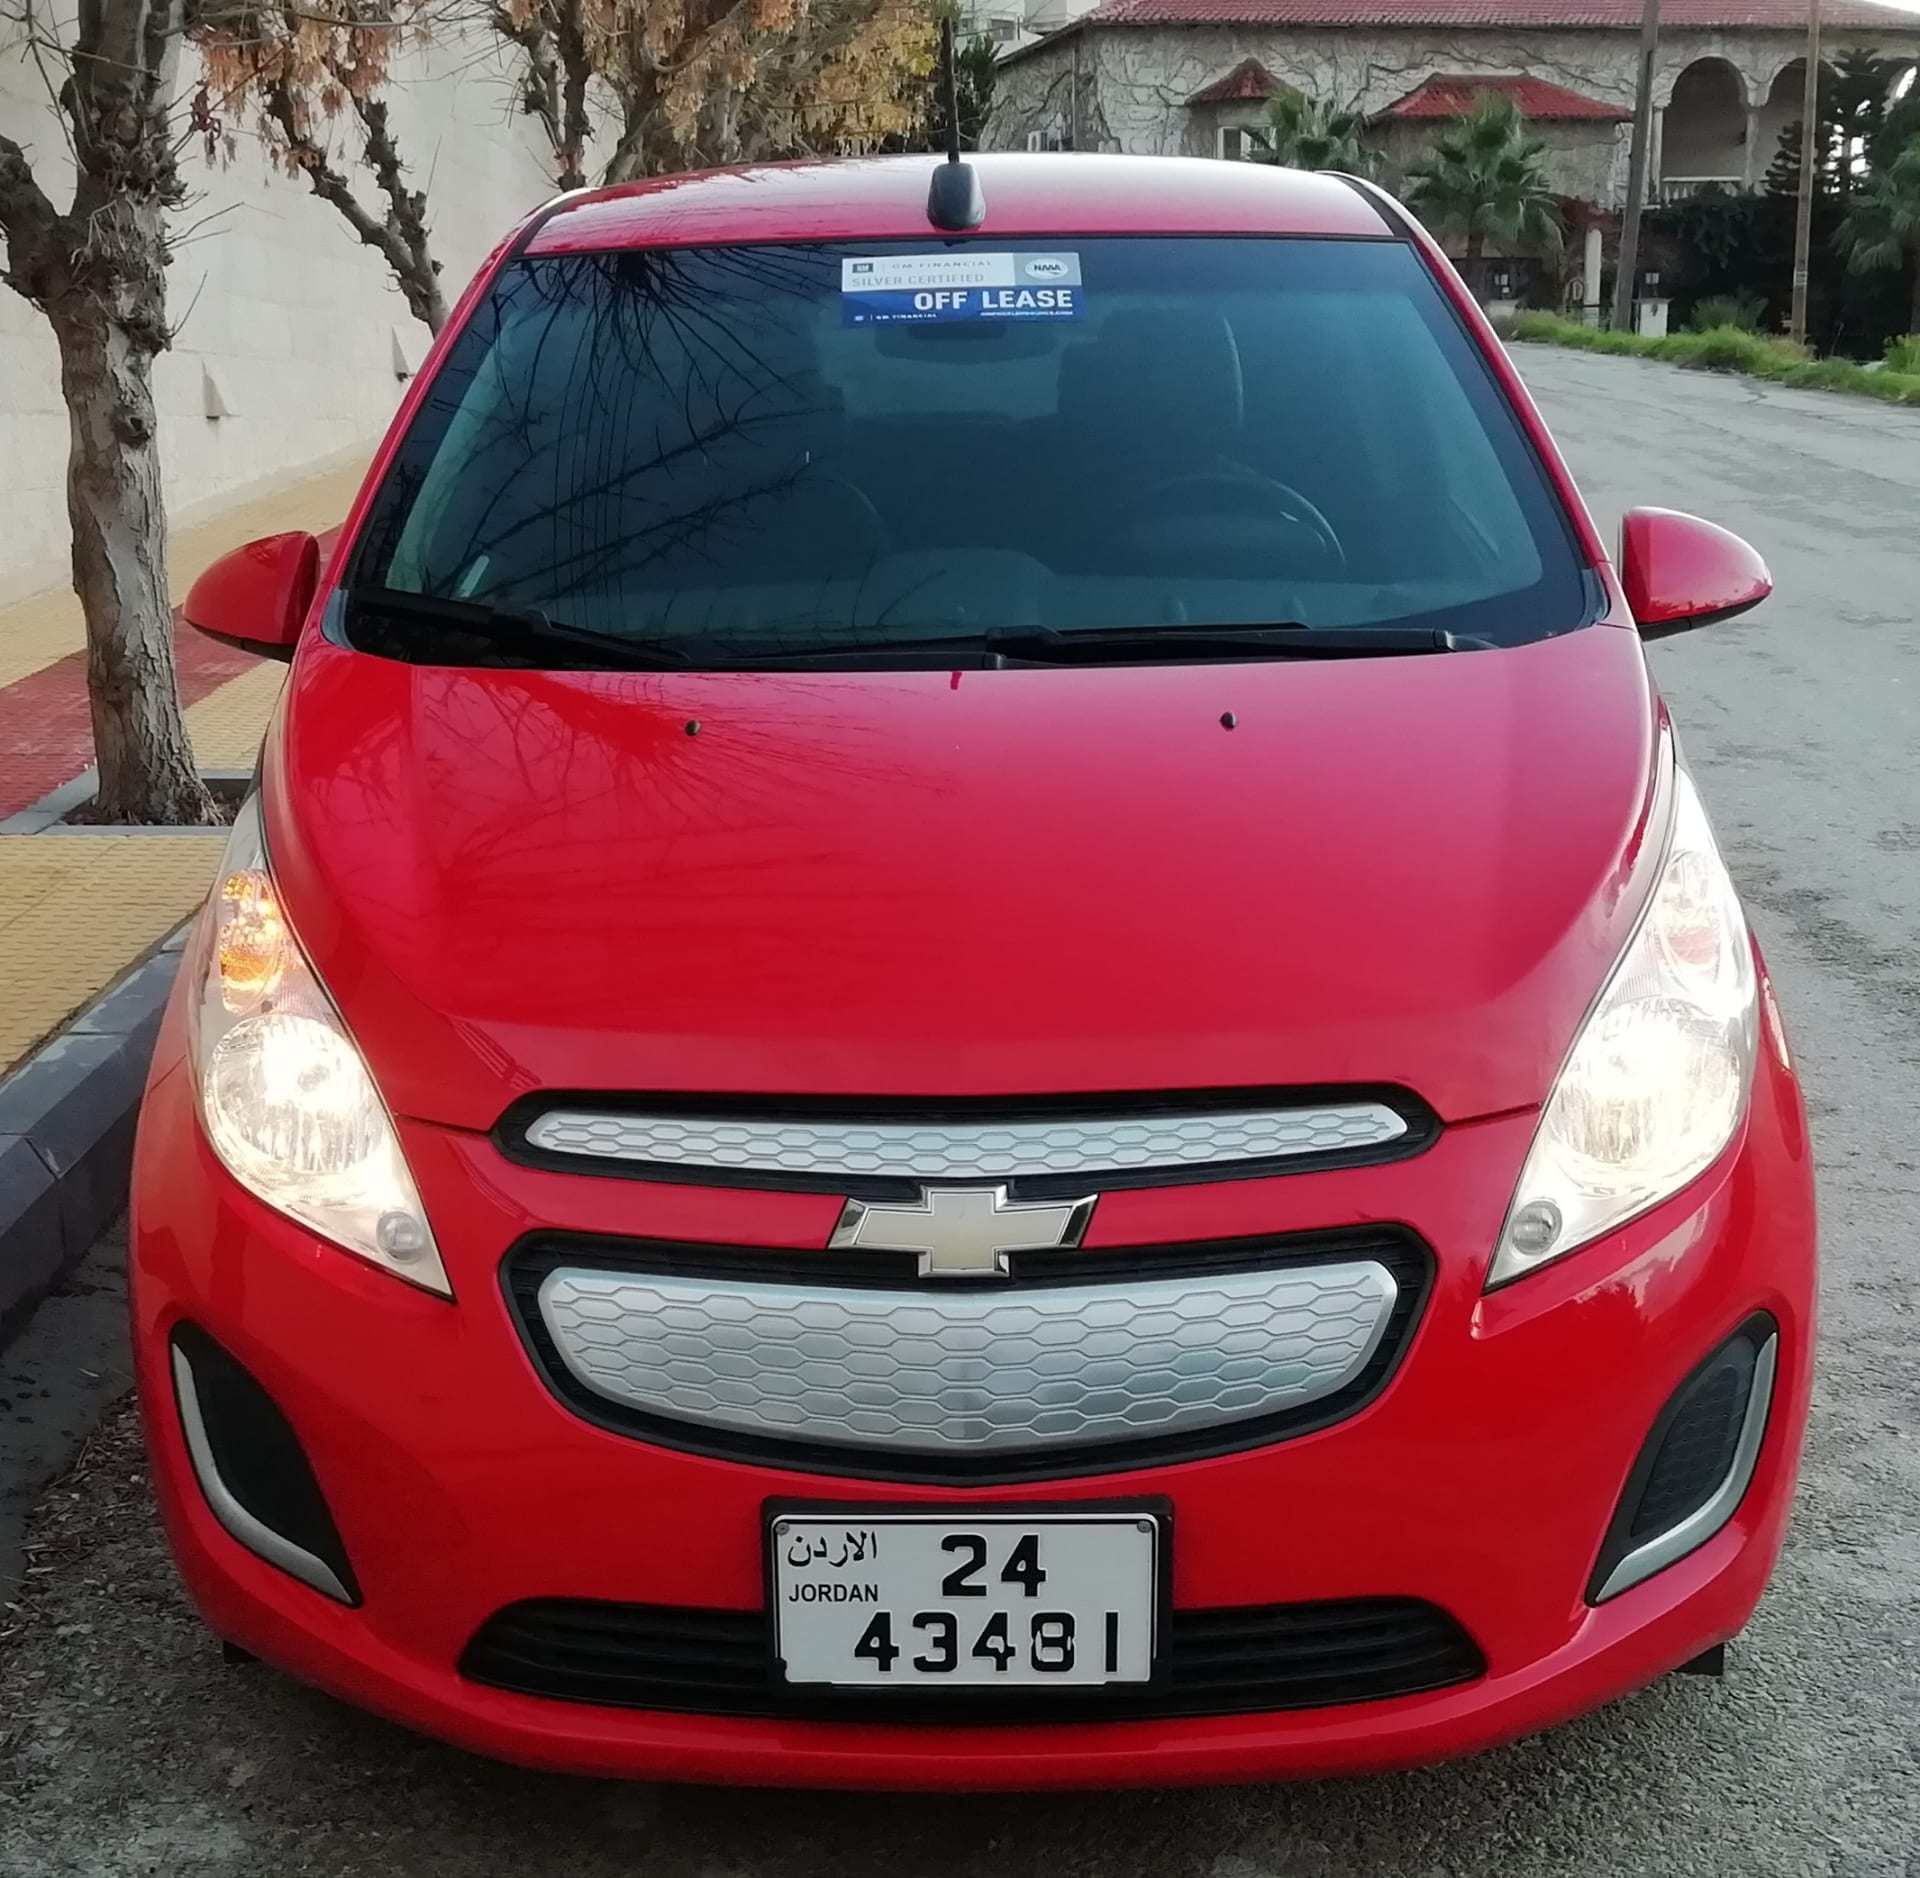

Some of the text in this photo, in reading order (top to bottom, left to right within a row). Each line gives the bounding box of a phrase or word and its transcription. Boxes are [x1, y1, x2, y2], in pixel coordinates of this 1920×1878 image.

[919, 260, 992, 269] FINANCIAL
[851, 272, 985, 288] SILVER CERTIFIED
[914, 289, 1073, 311] OFF LEASE
[940, 1533, 1047, 1599] 24
[788, 1583, 879, 1603] JORDAN
[853, 1610, 1120, 1674] 43481
